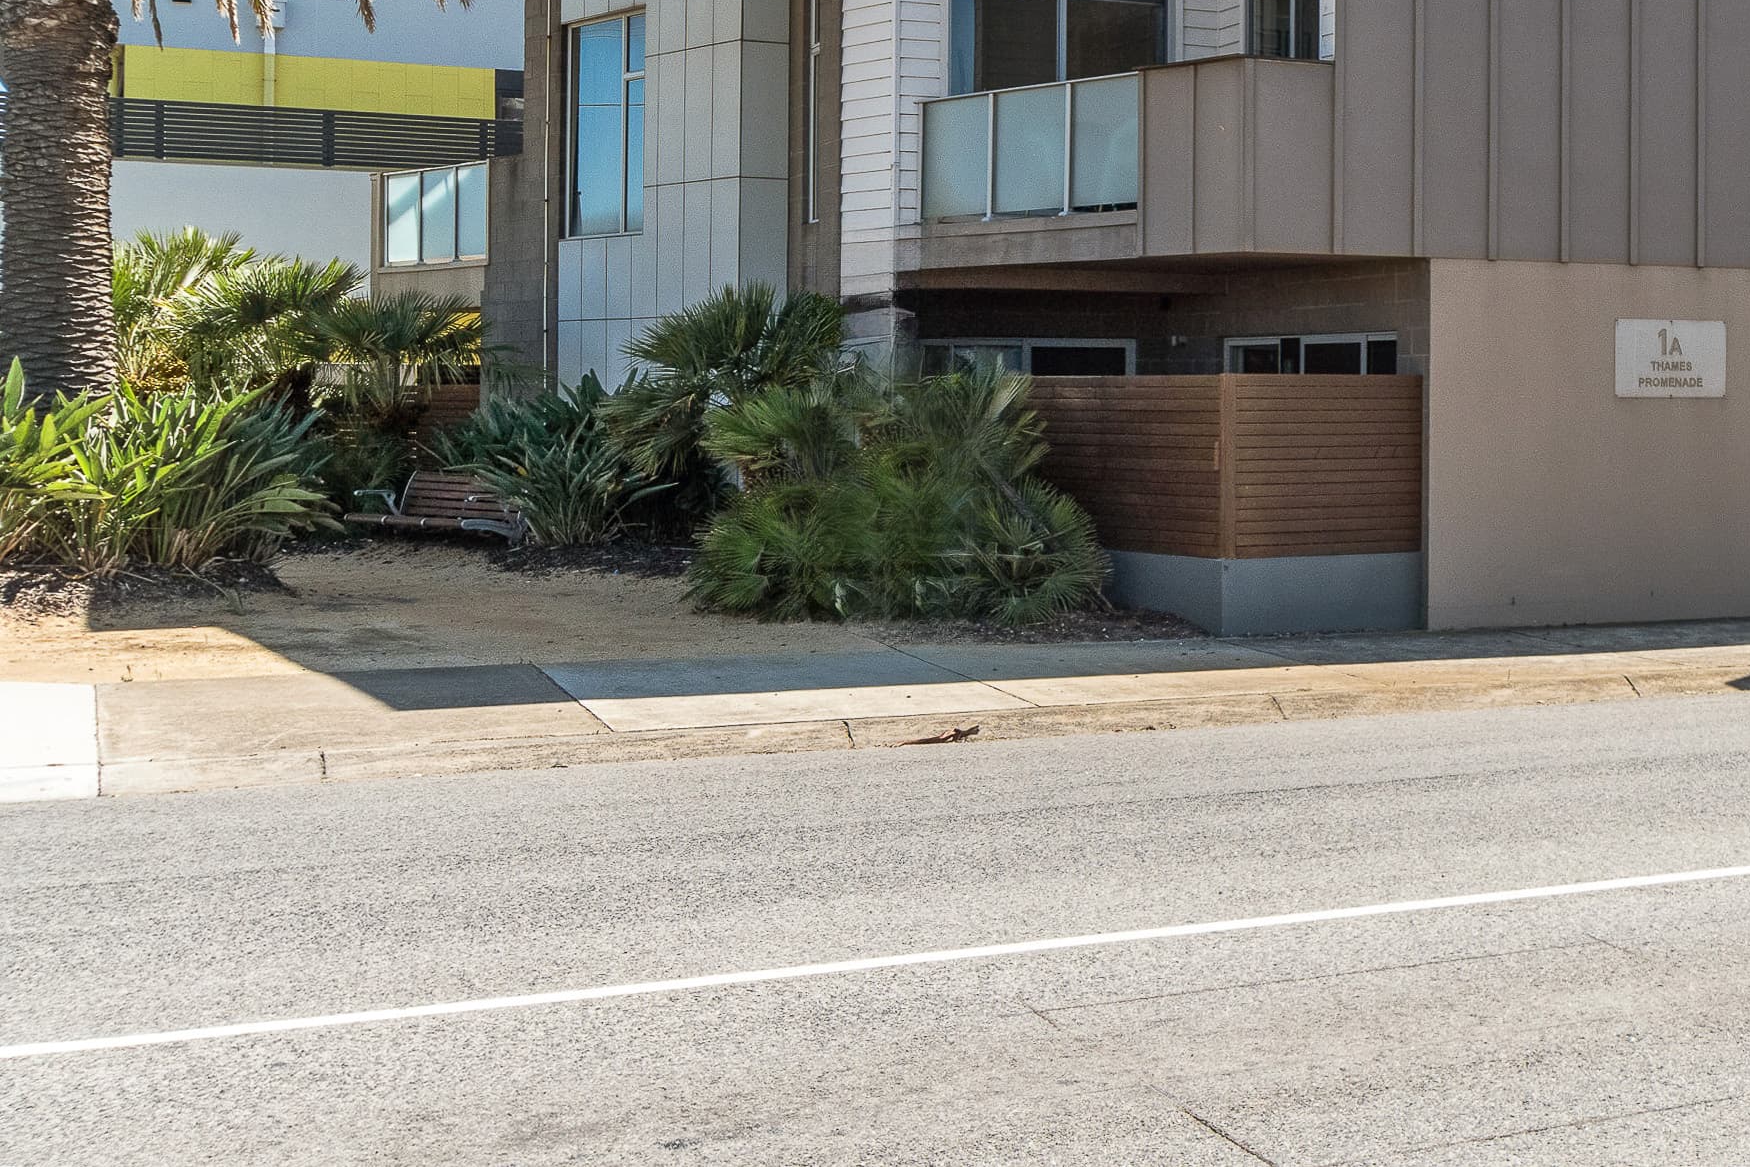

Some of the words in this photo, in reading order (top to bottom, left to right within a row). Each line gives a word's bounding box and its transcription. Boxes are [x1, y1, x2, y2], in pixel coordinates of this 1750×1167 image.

[1658, 328, 1683, 356] 1A
[1651, 361, 1692, 371] THAMES
[1638, 377, 1703, 388] PROMENADE
